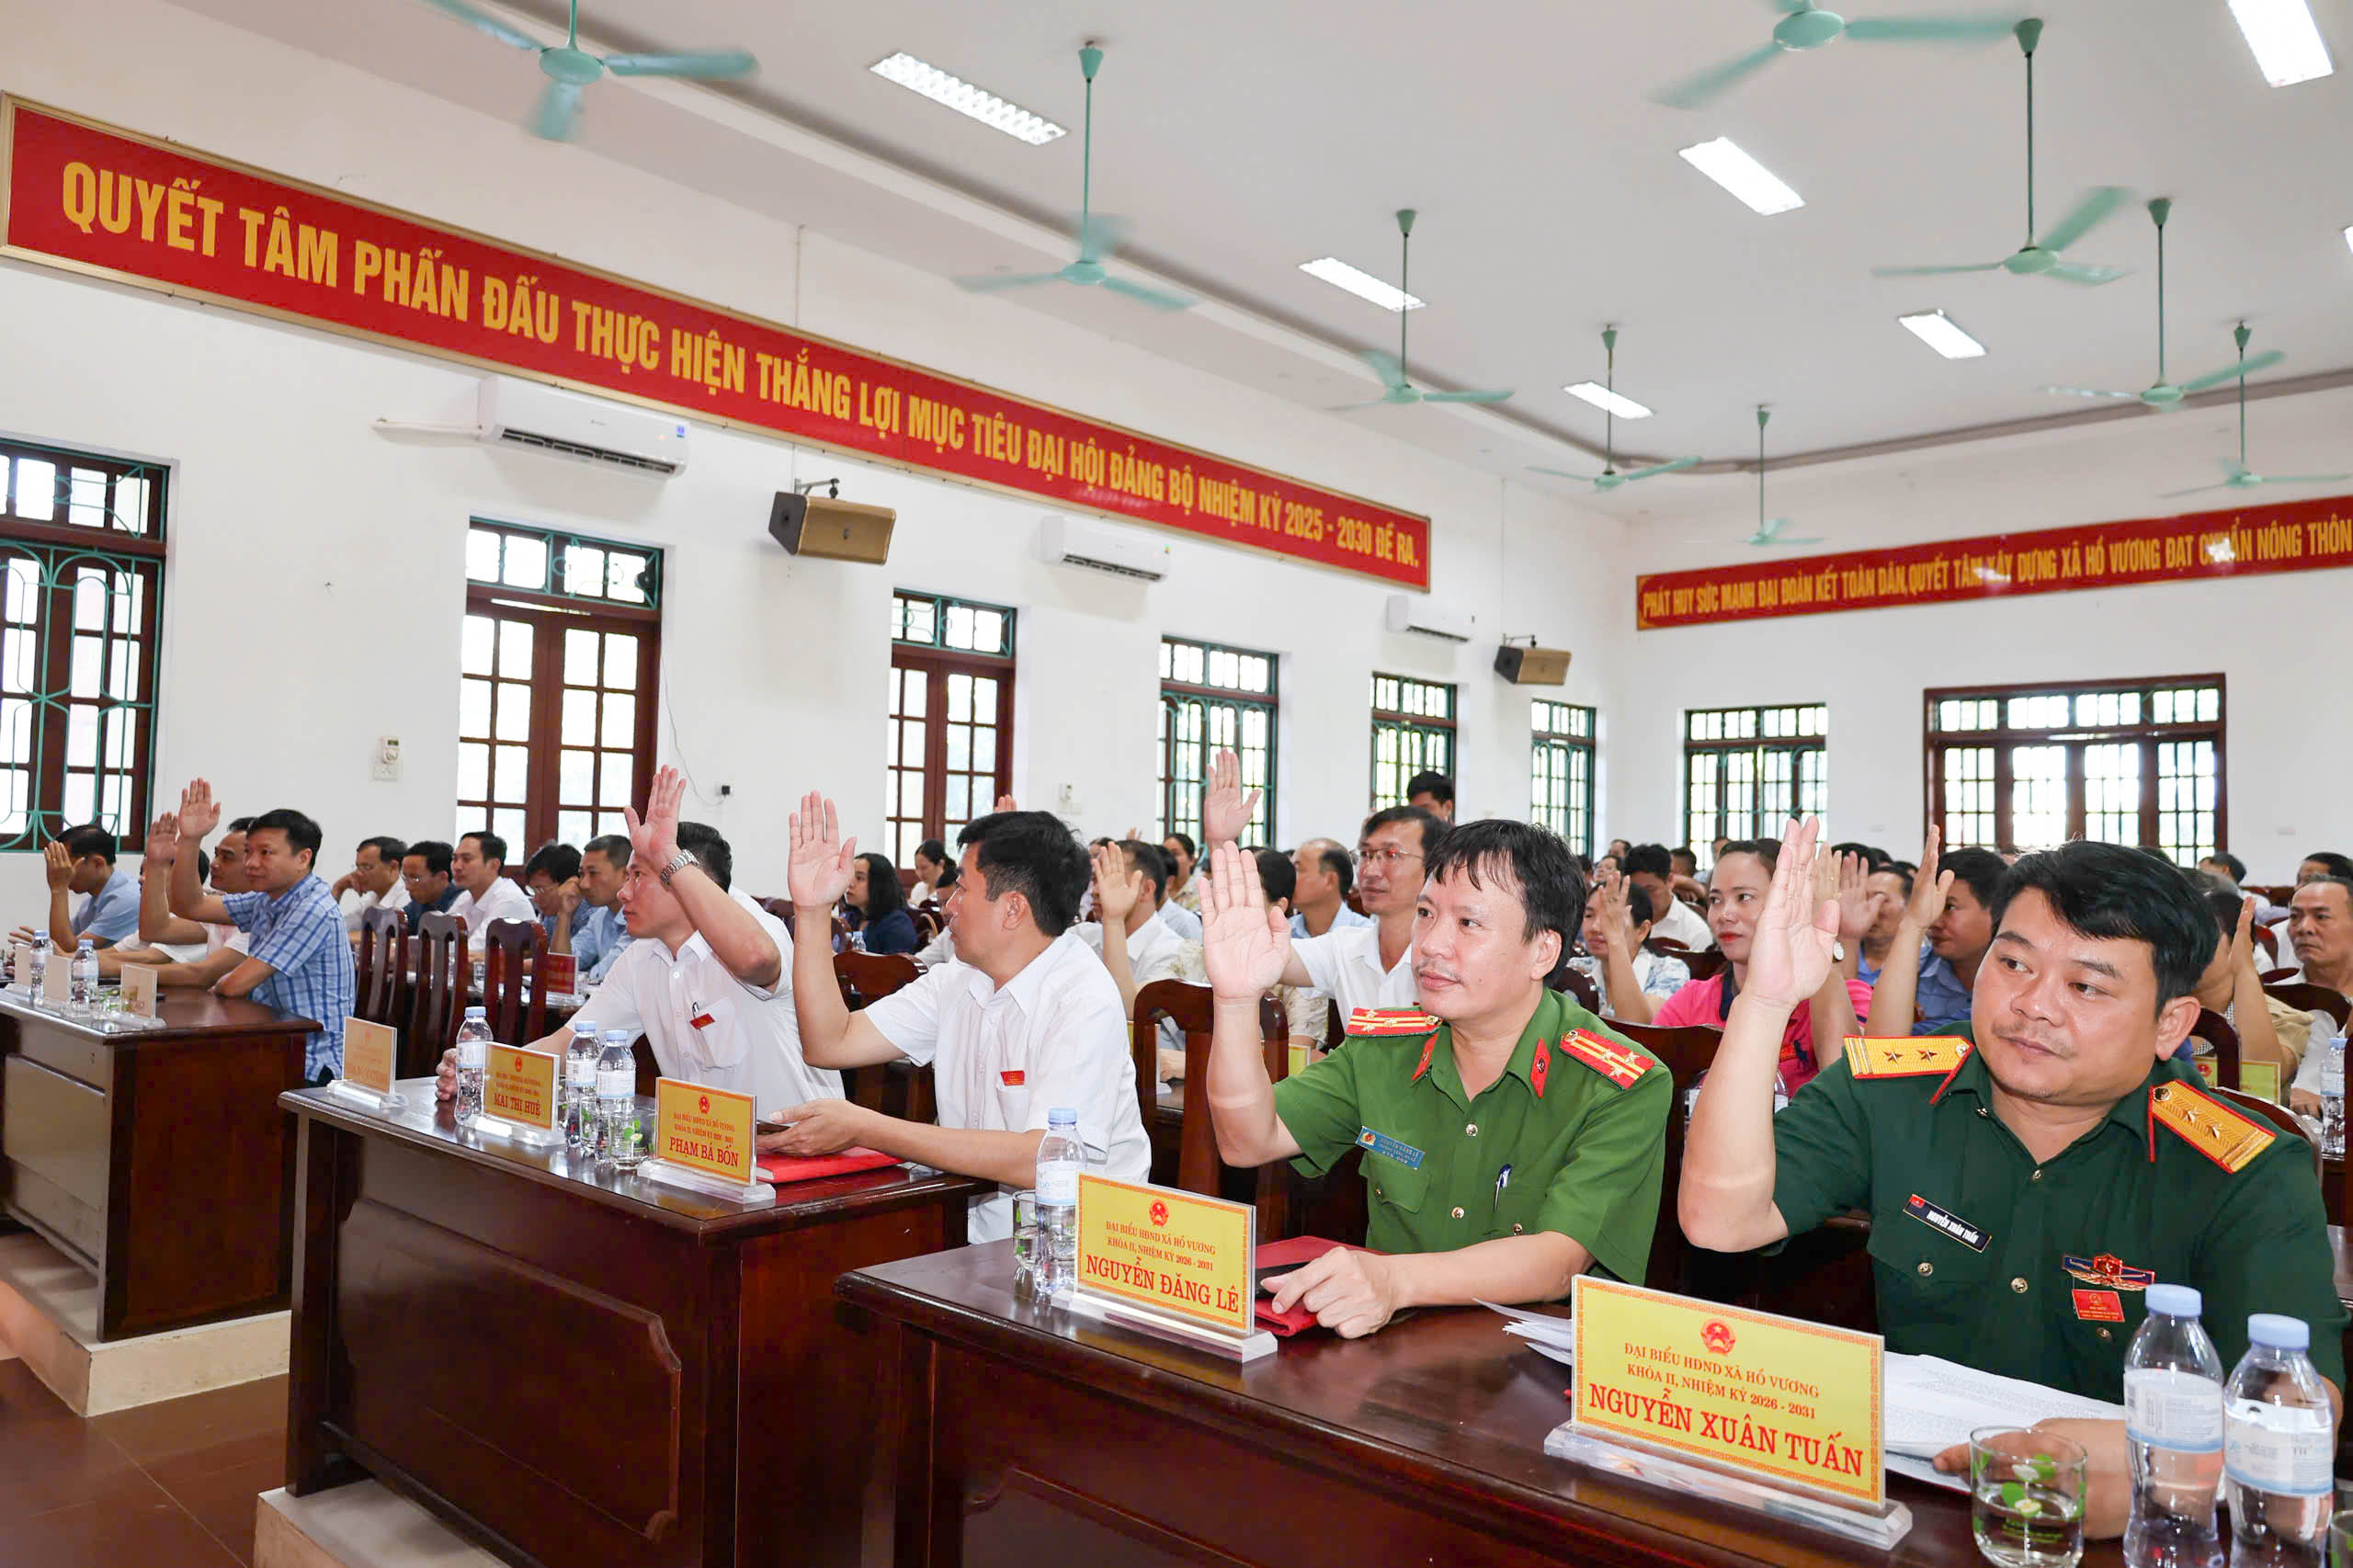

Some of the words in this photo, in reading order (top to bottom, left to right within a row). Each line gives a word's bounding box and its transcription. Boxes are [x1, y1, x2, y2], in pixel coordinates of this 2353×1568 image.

[63, 161, 224, 257] QUYẾT
[238, 205, 338, 288] TÂM
[354, 239, 469, 322] PHẤN
[483, 275, 559, 344] ĐẤU
[572, 300, 660, 374] THỰC
[671, 328, 745, 395] HIỆN
[756, 347, 851, 421] THẮNG
[859, 381, 901, 438] LỢI
[908, 393, 964, 454] MỤC
[972, 412, 1021, 464] TIÊU
[1027, 428, 1064, 482] ĐẠI
[1070, 437, 1105, 492] HỘI
[1109, 444, 1164, 502] ĐẢNG
[1168, 464, 1194, 516] BỘ
[1198, 476, 1256, 528] NHIỆM
[1259, 490, 1282, 532] KỲ
[1284, 501, 1324, 542] 2025
[1326, 524, 1334, 532] -
[1336, 516, 1372, 555] 2030
[1396, 531, 1419, 568] RA.
[1643, 586, 1670, 619] PHÁT
[1673, 588, 1694, 617] HUY
[1697, 582, 1719, 614] SỨC
[1721, 582, 1756, 614] MẠNH
[1757, 579, 1779, 610] ĐẠI
[1815, 563, 1838, 601] KẾT
[1841, 563, 1875, 598] TOÀN
[1908, 552, 1949, 596] QUYẾT
[2017, 548, 2057, 585] DỰNG
[2061, 540, 2082, 578] XÃ
[2109, 537, 2161, 574] VƯƠNG
[2165, 535, 2194, 572] ĐẠT
[2256, 520, 2302, 560] NÔNG
[2307, 513, 2352, 555] THÔN
[669, 1136, 699, 1158] PHẠM
[700, 1142, 714, 1162] BÁ
[717, 1144, 739, 1167] BỐN
[1187, 1239, 1216, 1255] VƯƠNG
[1197, 1259, 1213, 1271] 2031
[1086, 1254, 1155, 1290] NGUYỄN
[1160, 1273, 1211, 1305] ĐĂNG
[1215, 1284, 1239, 1313] LÊ
[1625, 1342, 1646, 1358] ĐẠI
[1650, 1346, 1680, 1366] BIỂU
[1724, 1365, 1743, 1381] XÃ
[1769, 1375, 1820, 1398] VƯƠNG
[1628, 1363, 1663, 1382] KHÓA
[1665, 1372, 1678, 1388] II,
[1682, 1376, 1725, 1397] NHIỆM
[1750, 1393, 1779, 1410] 2026
[1788, 1403, 1816, 1419] 2031
[1589, 1382, 1693, 1433] NGUYỄN
[1699, 1411, 1778, 1455] XUÂN
[1784, 1430, 1864, 1477] TUẤN
